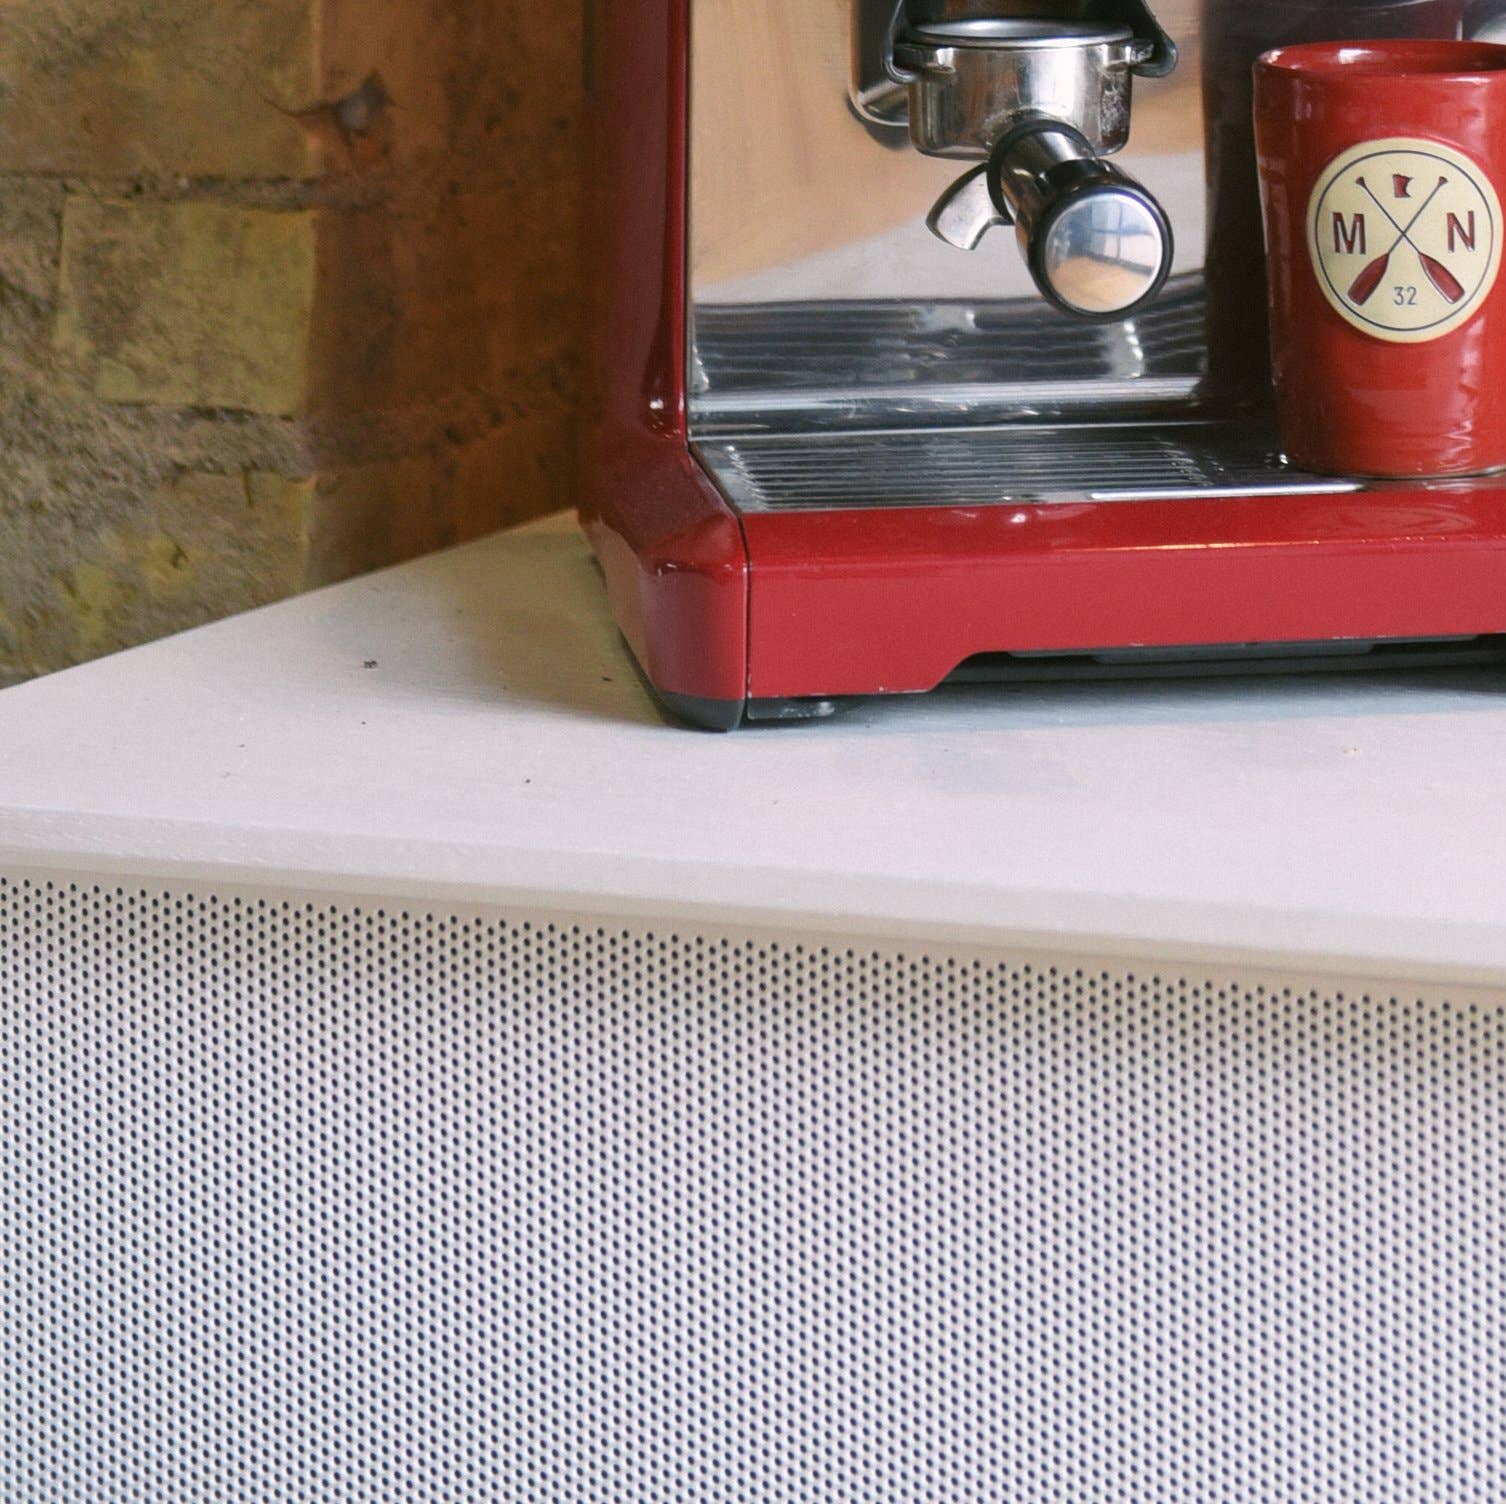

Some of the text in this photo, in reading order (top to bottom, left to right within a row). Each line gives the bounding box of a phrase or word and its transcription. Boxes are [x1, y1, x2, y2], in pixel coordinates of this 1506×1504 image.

[1331, 210, 1476, 255] M N
[1393, 286, 1417, 306] 32
